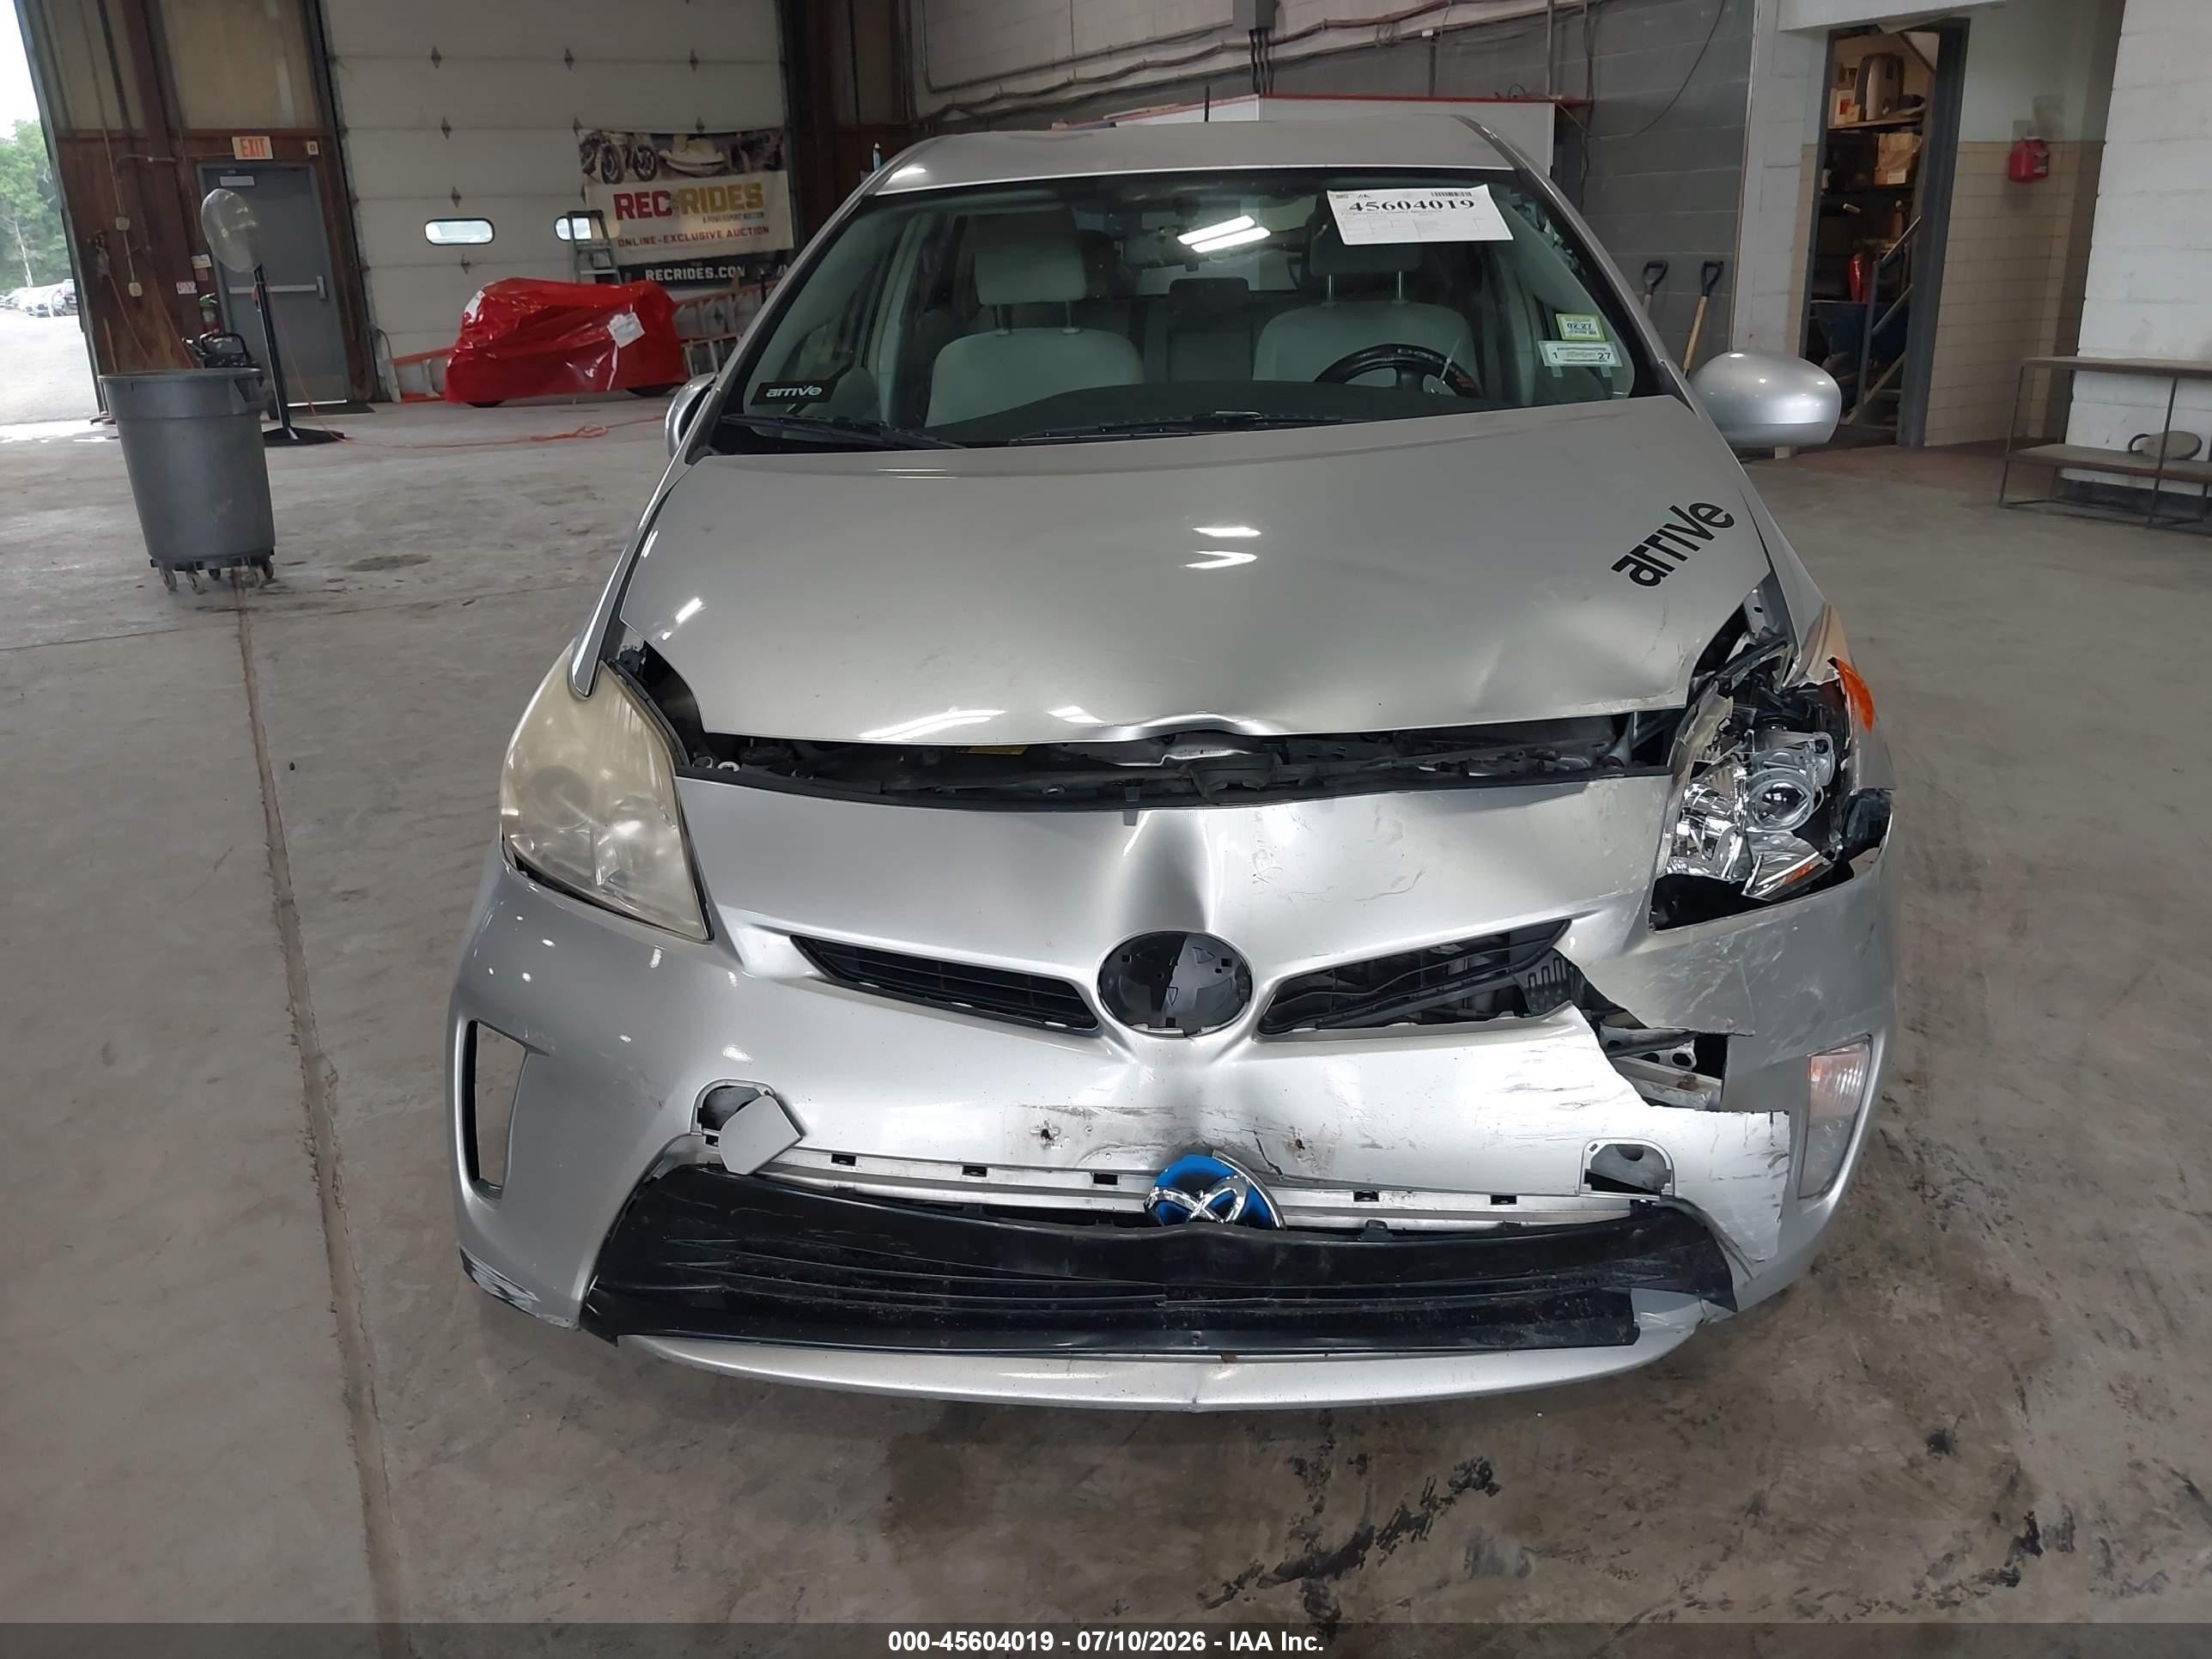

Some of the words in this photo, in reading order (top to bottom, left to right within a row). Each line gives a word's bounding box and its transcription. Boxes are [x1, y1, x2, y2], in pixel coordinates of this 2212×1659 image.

[240, 137, 267, 157] EXIT
[613, 190, 673, 221] REC
[678, 182, 764, 216] RIDES
[1349, 199, 1475, 212] 45604019
[617, 230, 722, 247] ONLINE-EXCLUSIVE
[726, 226, 769, 238] AUCTION
[766, 386, 823, 398] arrive
[1611, 502, 1735, 586] arrive
